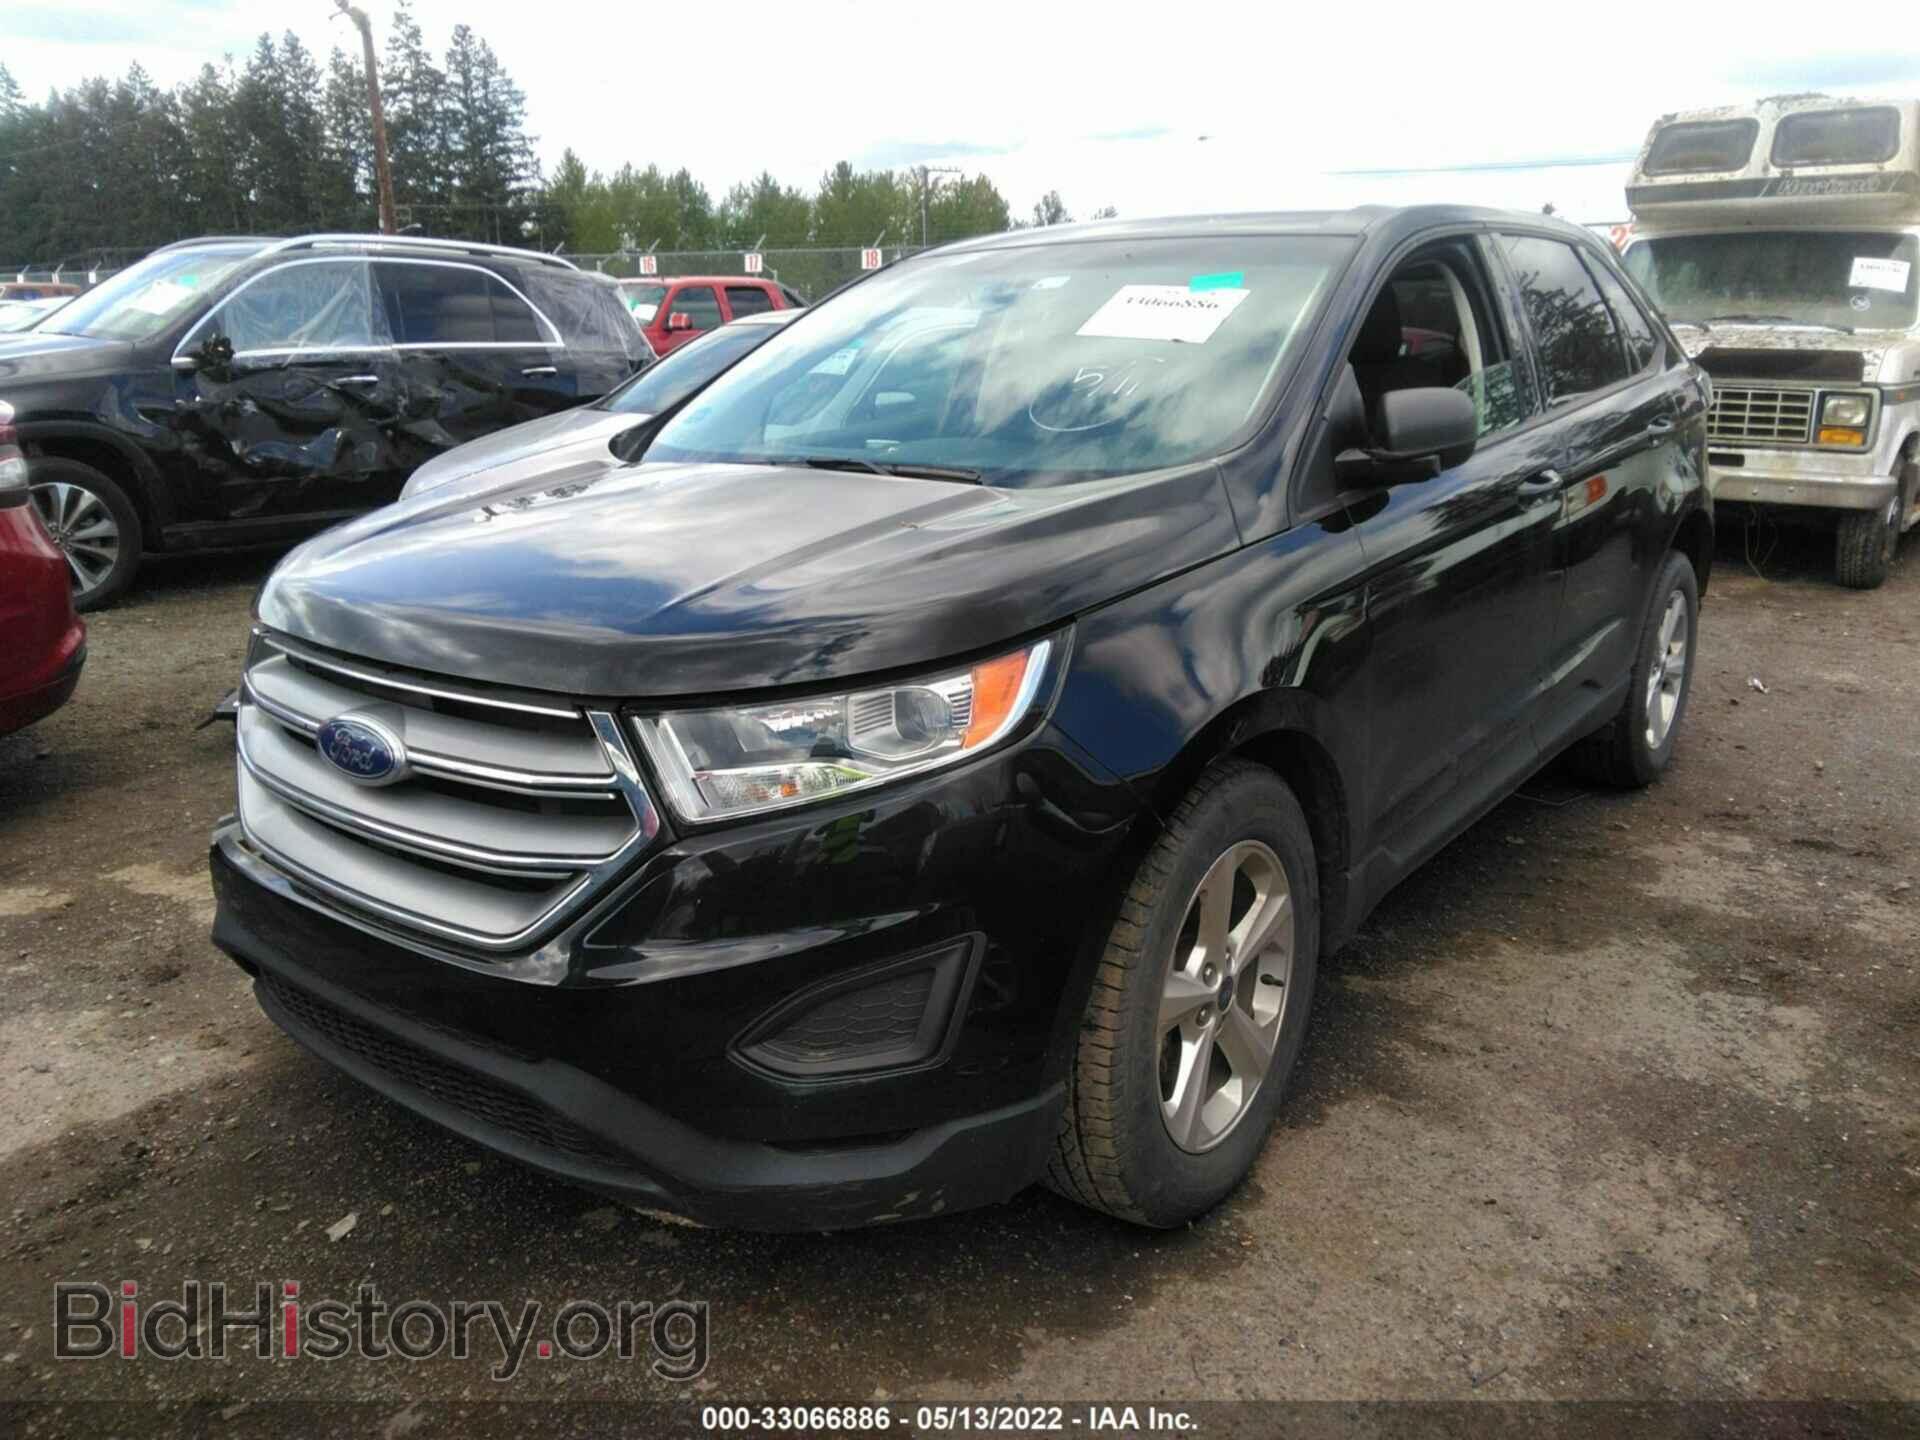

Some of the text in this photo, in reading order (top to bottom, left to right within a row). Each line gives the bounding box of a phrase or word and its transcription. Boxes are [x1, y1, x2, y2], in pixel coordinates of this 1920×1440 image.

[643, 255, 655, 272] 16
[748, 254, 760, 271] 17
[865, 249, 879, 268] 18
